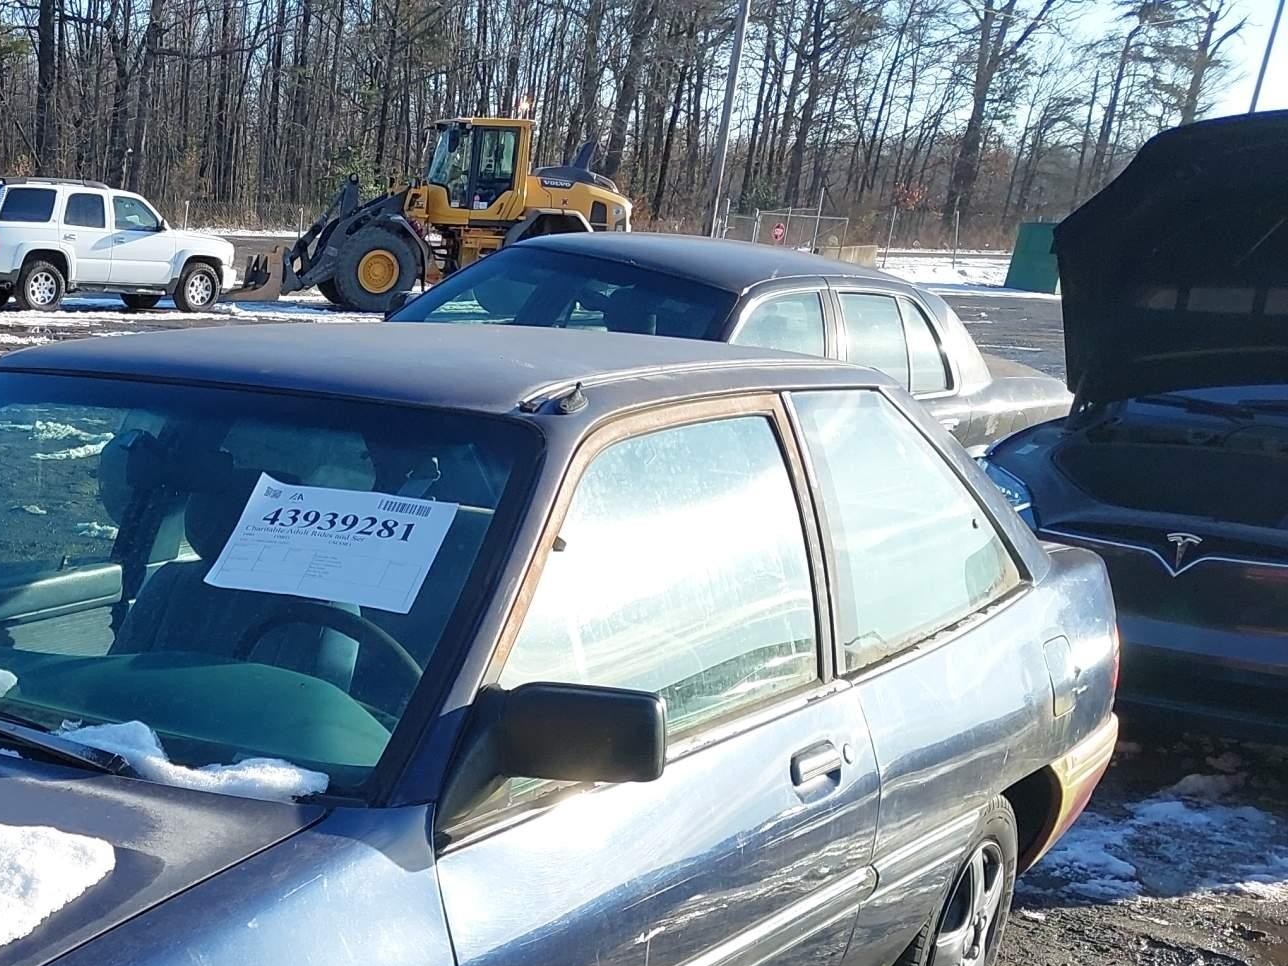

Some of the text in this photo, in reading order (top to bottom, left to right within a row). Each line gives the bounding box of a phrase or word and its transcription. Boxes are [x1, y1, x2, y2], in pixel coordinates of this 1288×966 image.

[543, 179, 572, 188] VOLVO
[262, 507, 416, 542] 43939281
[245, 525, 284, 535] Charitable
[311, 530, 333, 538] Rides
